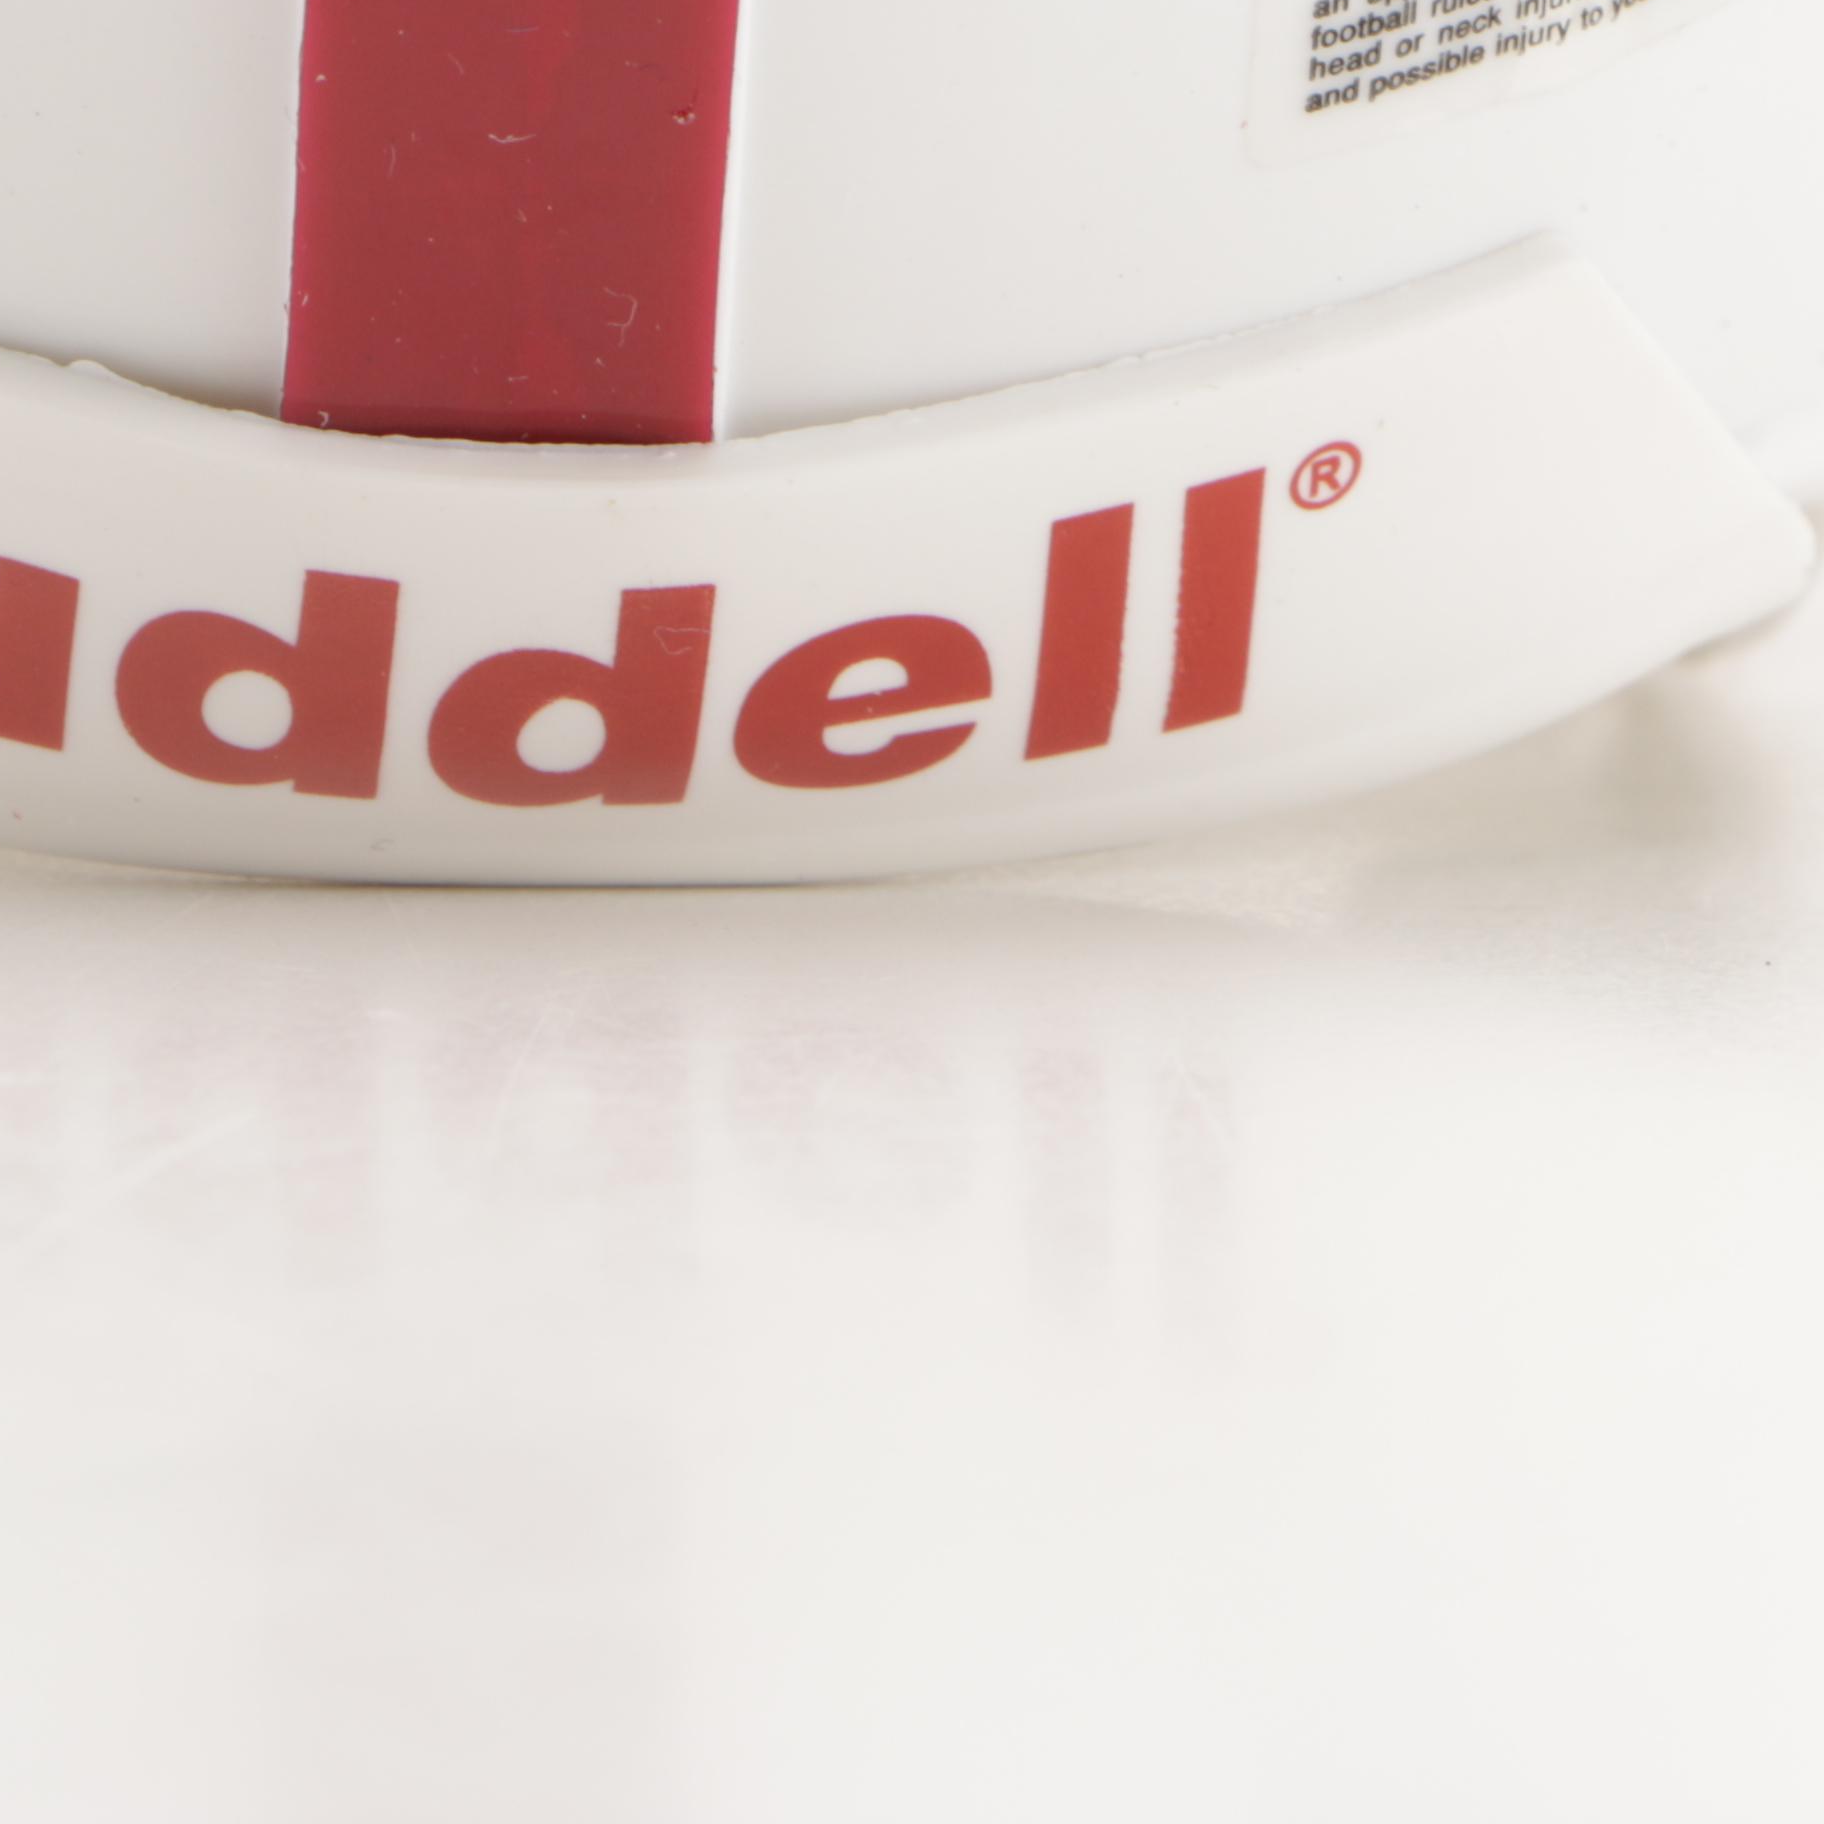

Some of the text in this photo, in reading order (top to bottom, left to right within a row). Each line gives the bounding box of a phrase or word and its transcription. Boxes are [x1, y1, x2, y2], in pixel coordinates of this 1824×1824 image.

[1305, 79, 1360, 113] and
[1368, 43, 1486, 101] possible
[1495, 18, 1571, 57] injury
[1581, 3, 1604, 31] to
[1309, 39, 1382, 81] head
[1395, 32, 1424, 60] or
[1437, 5, 1502, 46] neck
[1311, 0, 1418, 51] football
